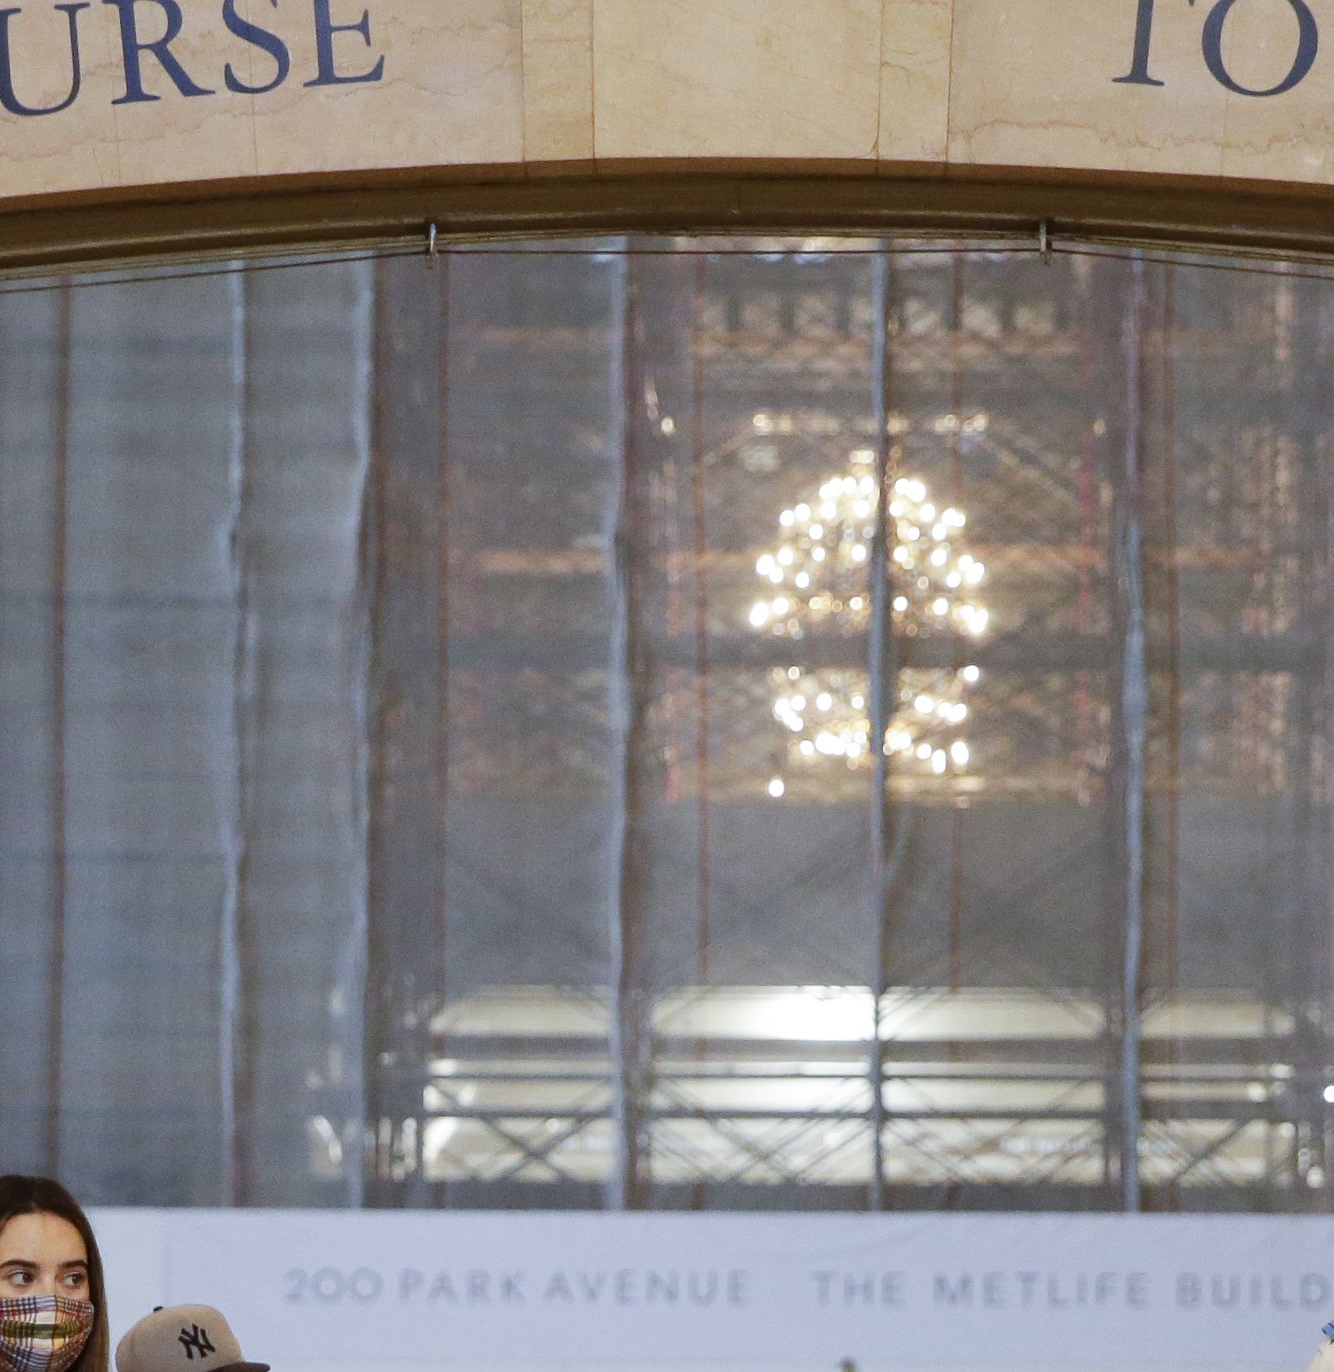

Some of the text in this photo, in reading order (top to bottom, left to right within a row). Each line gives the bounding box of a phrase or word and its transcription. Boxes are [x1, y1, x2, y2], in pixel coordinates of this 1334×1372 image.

[1111, 0, 1319, 97] TO
[283, 1267, 384, 1305] 200
[396, 1268, 526, 1305] PARK
[543, 1268, 752, 1306] AVENUE
[811, 1270, 906, 1306] THE
[931, 1270, 1151, 1308] METLIFE
[178, 1323, 216, 1359] NY
